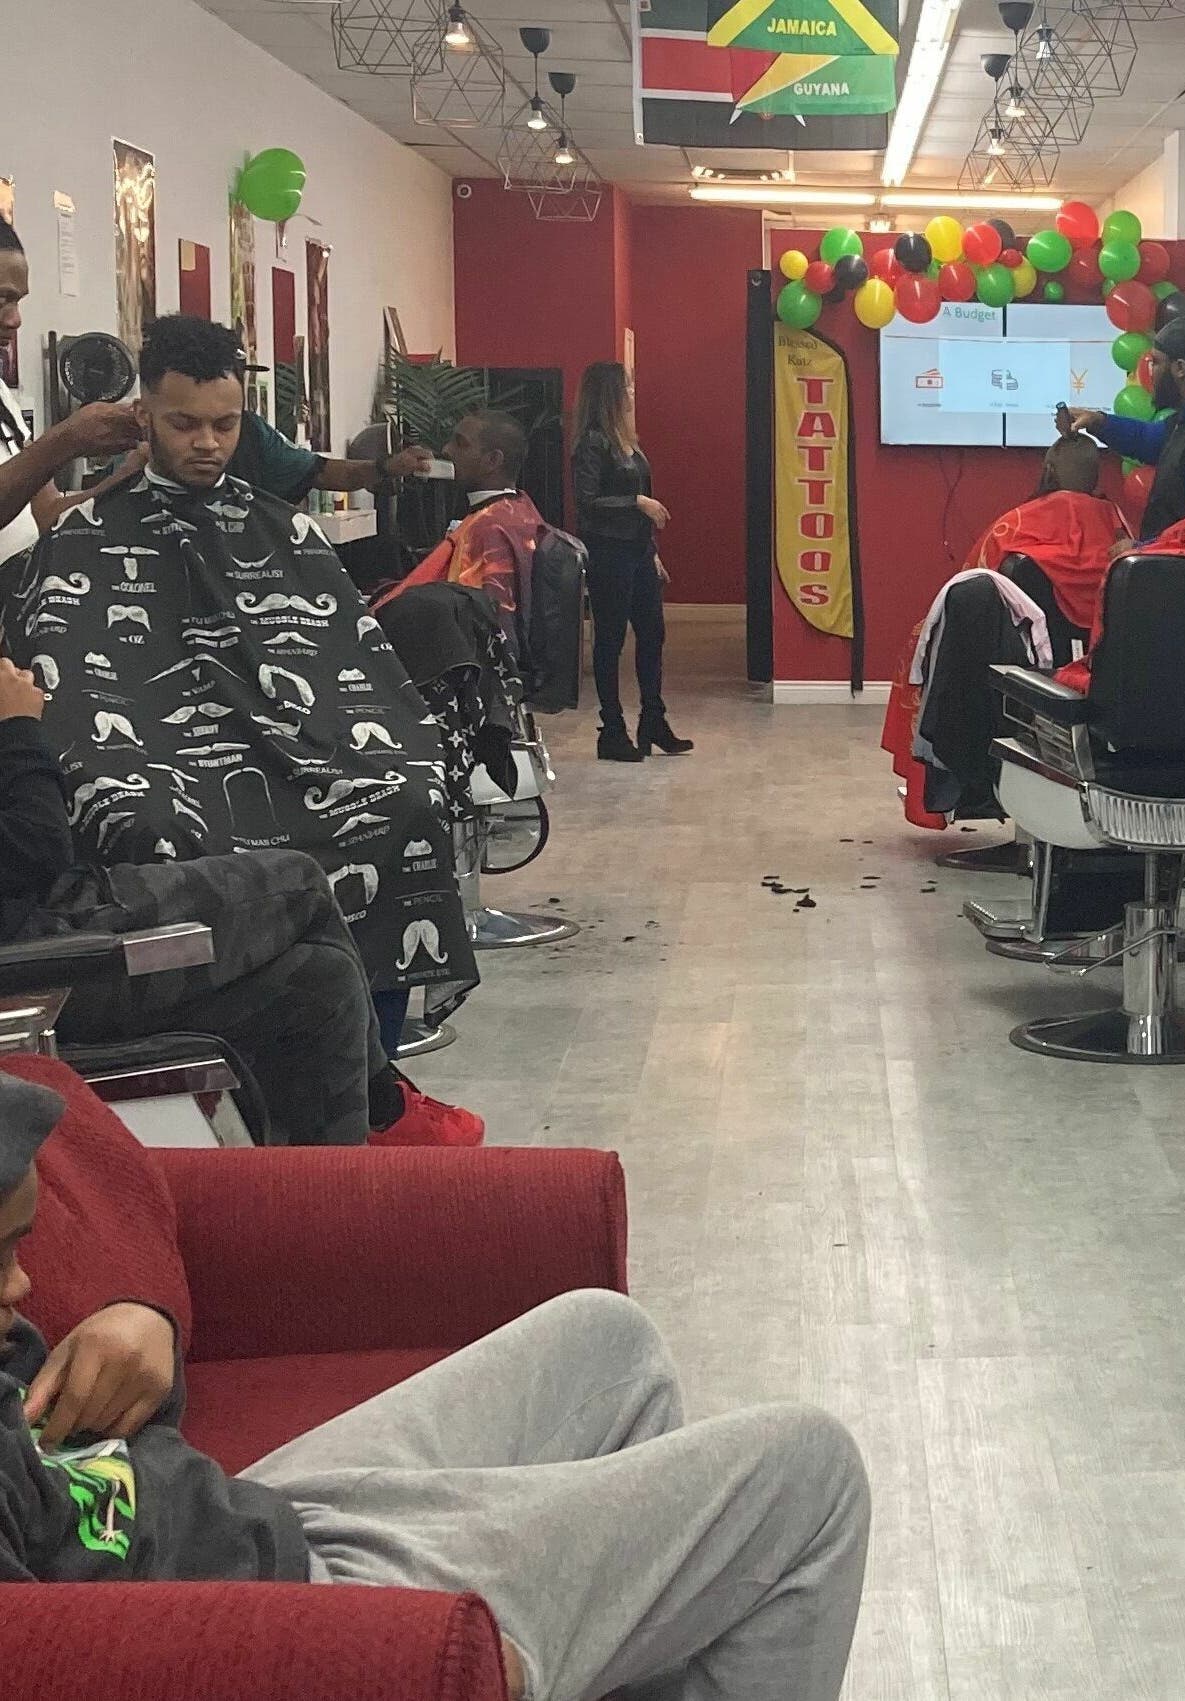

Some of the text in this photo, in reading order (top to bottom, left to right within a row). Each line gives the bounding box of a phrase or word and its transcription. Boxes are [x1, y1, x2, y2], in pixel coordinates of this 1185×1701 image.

[767, 18, 837, 36] JAMAICA
[793, 82, 850, 96] GUYANA
[954, 306, 996, 323] Budget
[778, 335, 818, 350] Blessed
[795, 376, 837, 606] TATTOOS
[234, 569, 284, 580] SURREALIST
[120, 581, 158, 593] COLONEL
[198, 753, 243, 768] STUNTMAN
